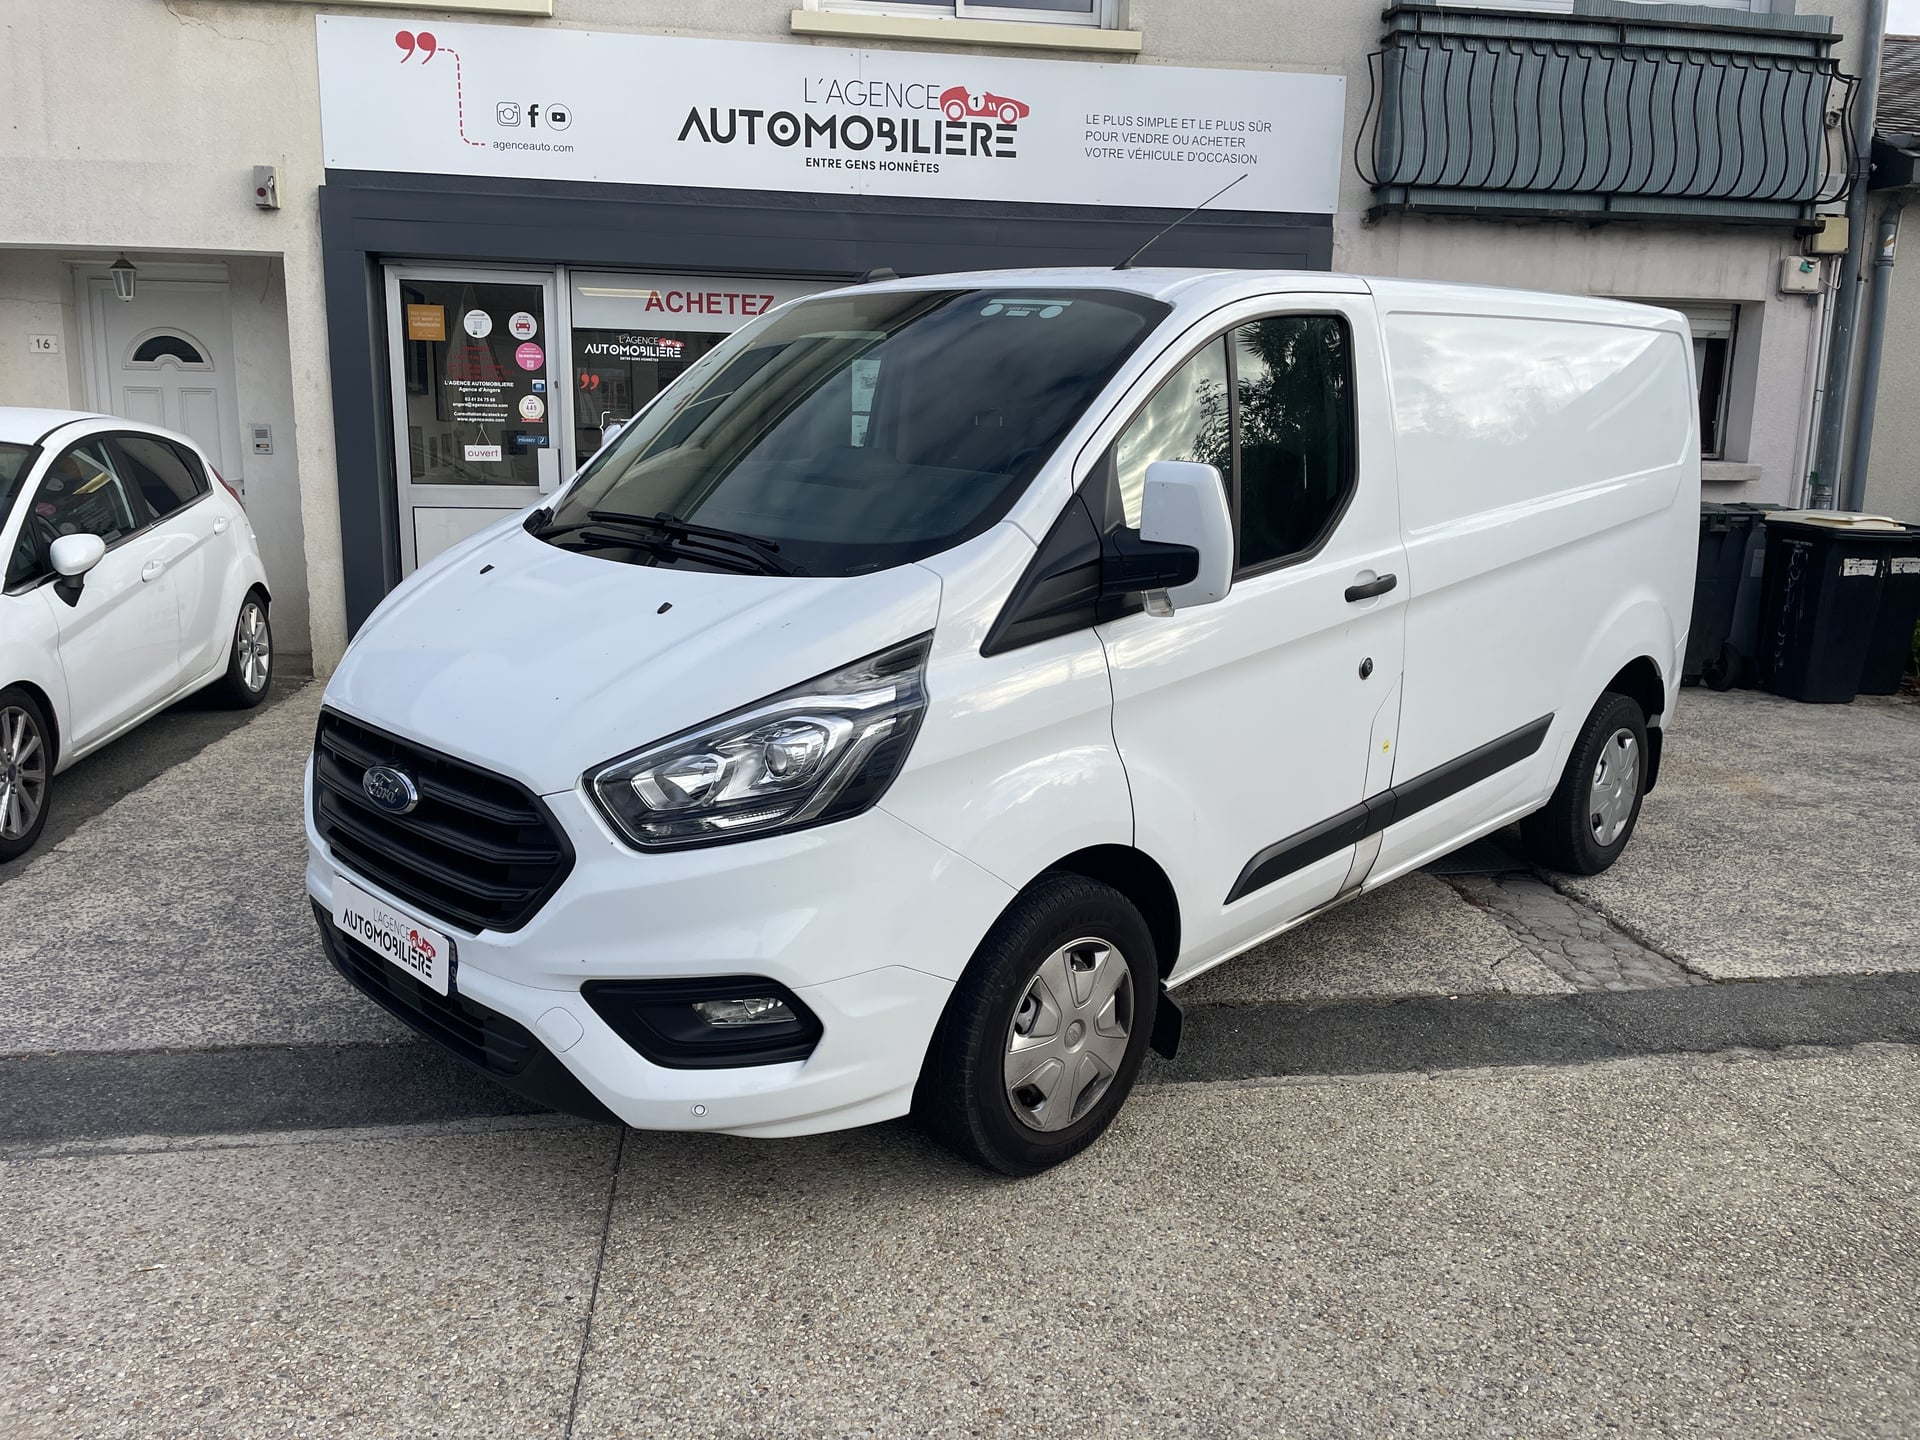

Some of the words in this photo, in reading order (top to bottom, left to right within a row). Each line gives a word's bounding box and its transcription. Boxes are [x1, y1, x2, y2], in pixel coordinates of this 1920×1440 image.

[1085, 114, 1100, 125] LE
[1103, 115, 1133, 126] PLUS
[1136, 116, 1178, 129] SIMPLE
[1181, 119, 1196, 129] ET
[1199, 119, 1213, 130] LE
[1216, 120, 1245, 132] PLUS
[1248, 120, 1272, 133] SÛR
[492, 141, 574, 153] agenceauto.com
[1085, 130, 1119, 142] POUR
[1122, 132, 1169, 145] VENDRE
[1172, 134, 1190, 146] OU
[1191, 135, 1246, 148] ACHETER
[1085, 147, 1124, 159] VOTRE
[1127, 147, 1184, 162] VÉHICULE
[1187, 151, 1258, 165] D'OCCASION
[805, 157, 842, 169] ENTRE
[845, 159, 876, 171] GENS
[879, 160, 940, 174] HONNÊTES
[644, 290, 775, 316] ACHETEZ
[36, 338, 50, 350] 16
[467, 449, 499, 457] ouvert
[368, 773, 399, 804] Ford
[373, 907, 411, 942] L'AGENCE
